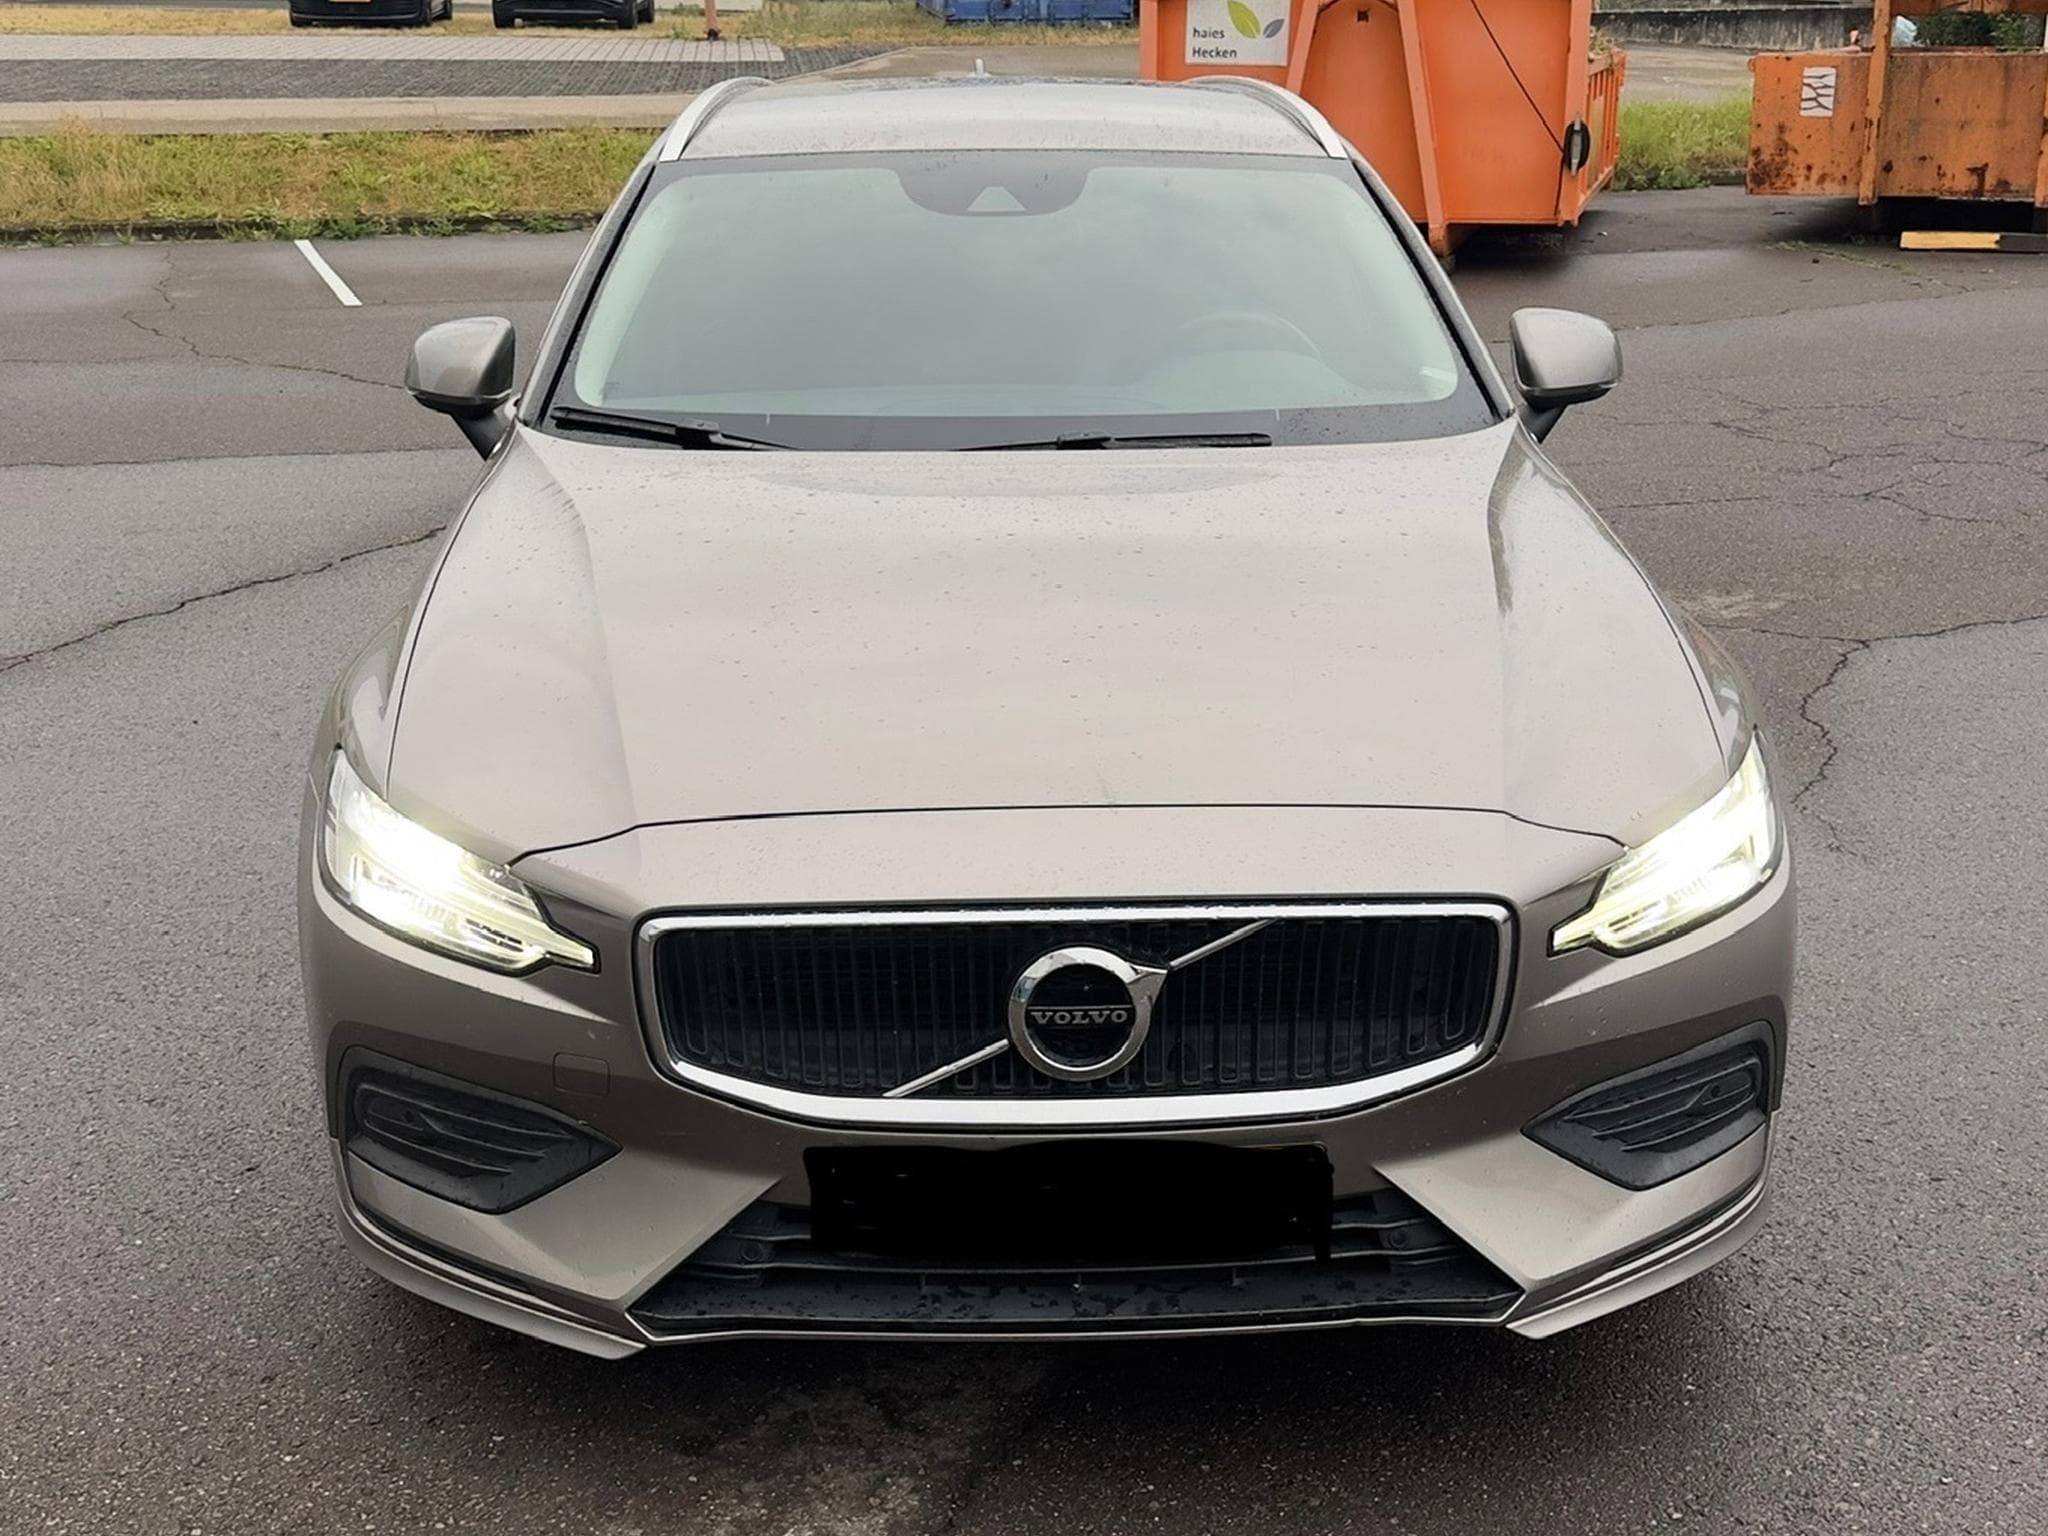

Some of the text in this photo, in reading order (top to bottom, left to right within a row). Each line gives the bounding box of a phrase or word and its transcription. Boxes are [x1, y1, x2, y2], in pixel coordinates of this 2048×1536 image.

[1193, 28, 1225, 39] haies
[1192, 47, 1237, 58] Hecken
[1031, 1011, 1128, 1024] VOLVO
